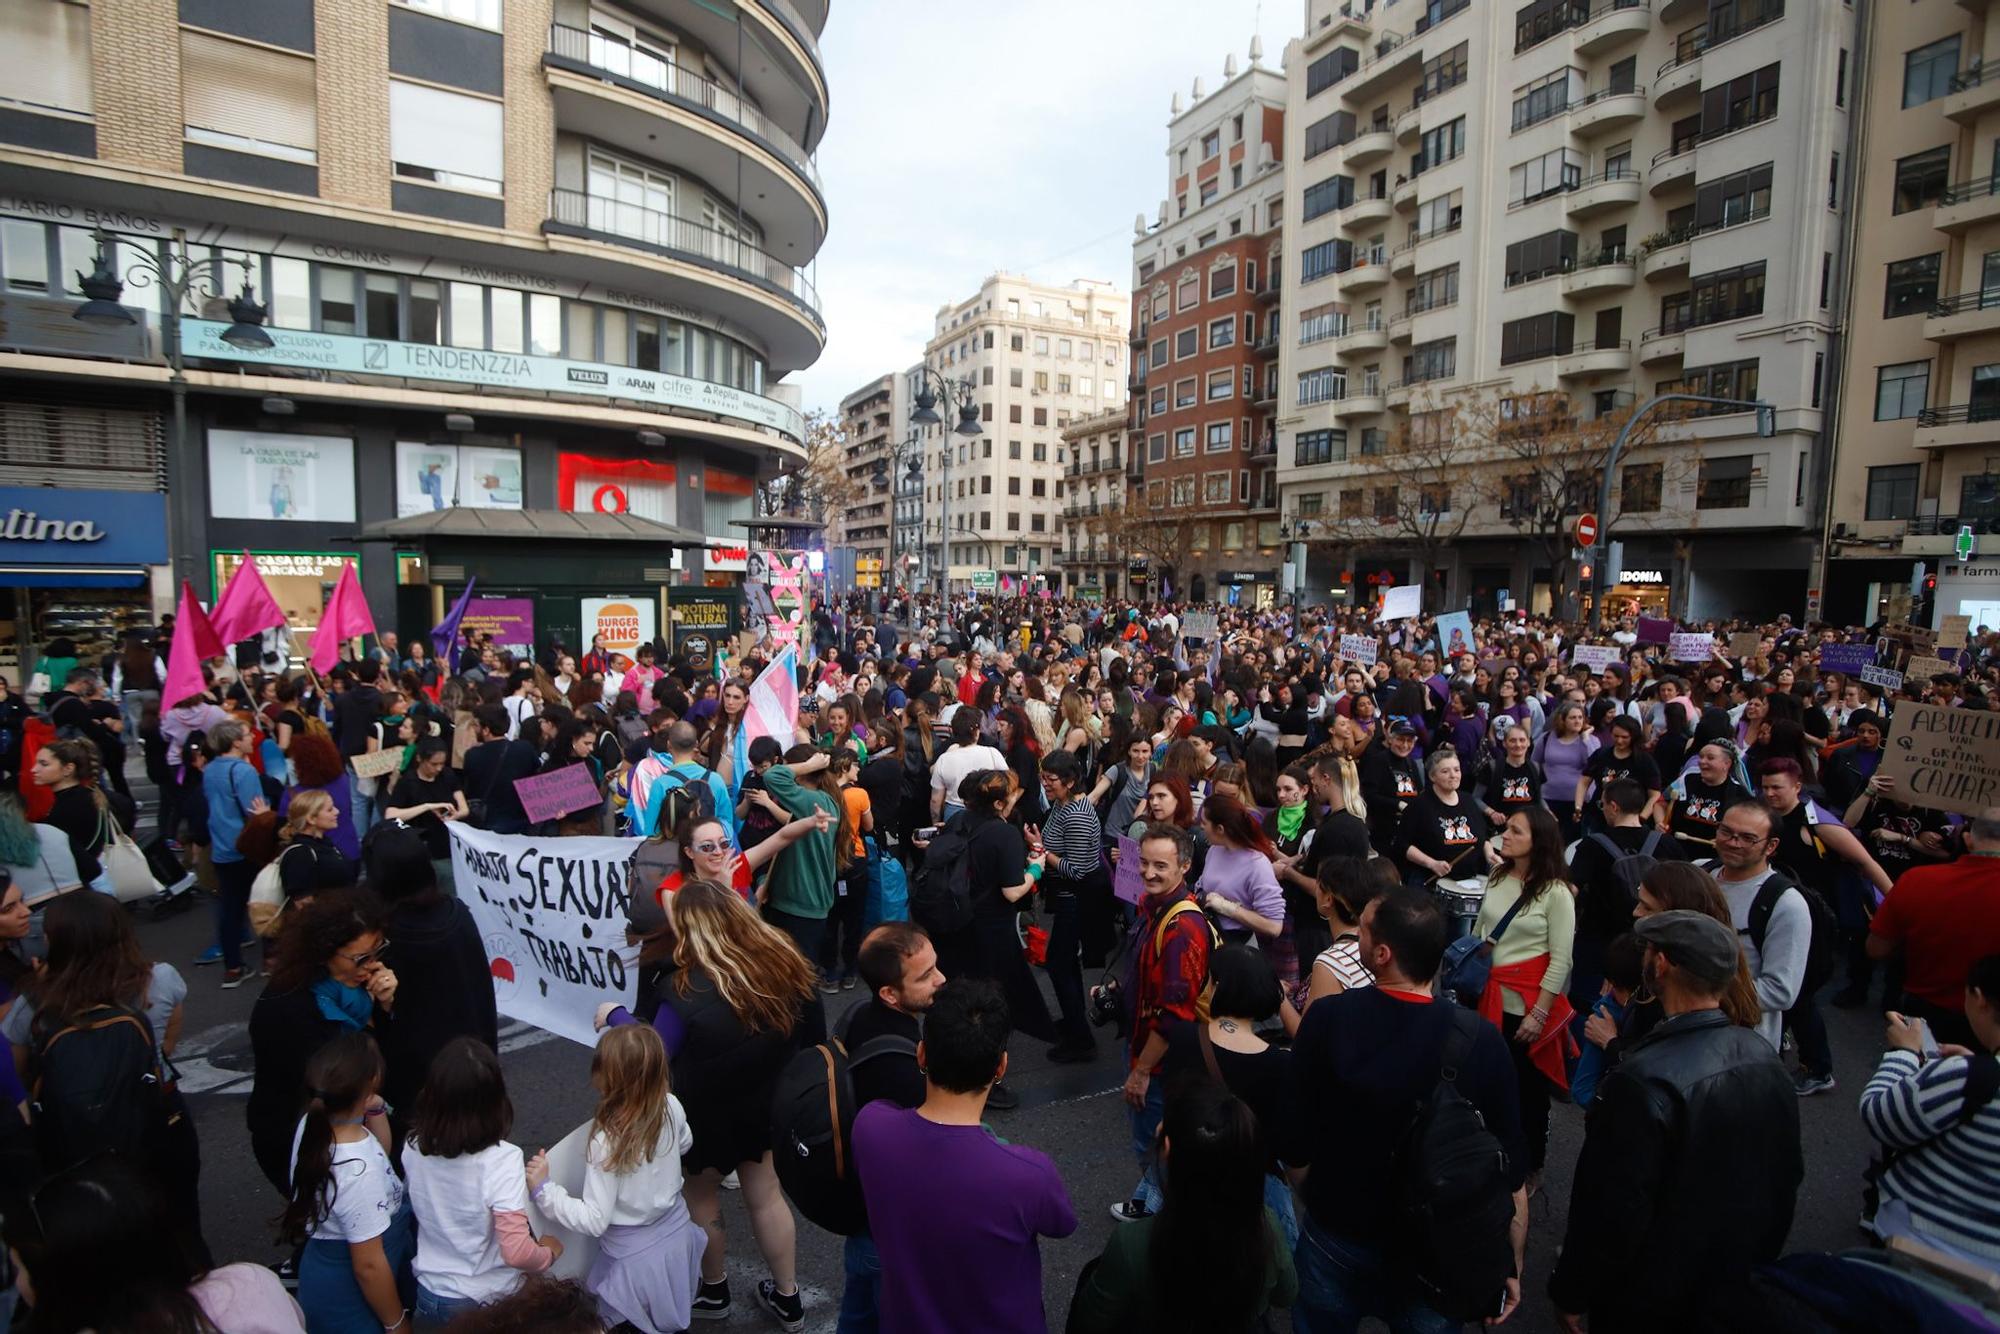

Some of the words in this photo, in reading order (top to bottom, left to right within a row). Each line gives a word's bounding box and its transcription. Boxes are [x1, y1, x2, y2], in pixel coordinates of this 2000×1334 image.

[84, 207, 162, 233] BAÑOS
[312, 243, 392, 267] COCINAS
[459, 263, 558, 290] PAVIMENTOS
[606, 288, 703, 321] REVESTIMIENTOS
[273, 335, 333, 350] XCLUSIVO
[402, 345, 532, 377] TENDENZZIA
[569, 370, 606, 382] VELUX
[625, 377, 655, 390] ARAN
[662, 379, 693, 394] cifre
[255, 556, 292, 566] CASA
[293, 556, 314, 566] DE
[316, 556, 343, 567] LAS
[1963, 565, 2000, 577] farm
[598, 617, 639, 627] BURGER
[599, 628, 639, 641] KING
[1344, 650, 1357, 660] NO
[1921, 757, 1947, 768] QUE
[1931, 747, 1985, 764] GRITAR
[519, 928, 627, 992] TRABAJO
